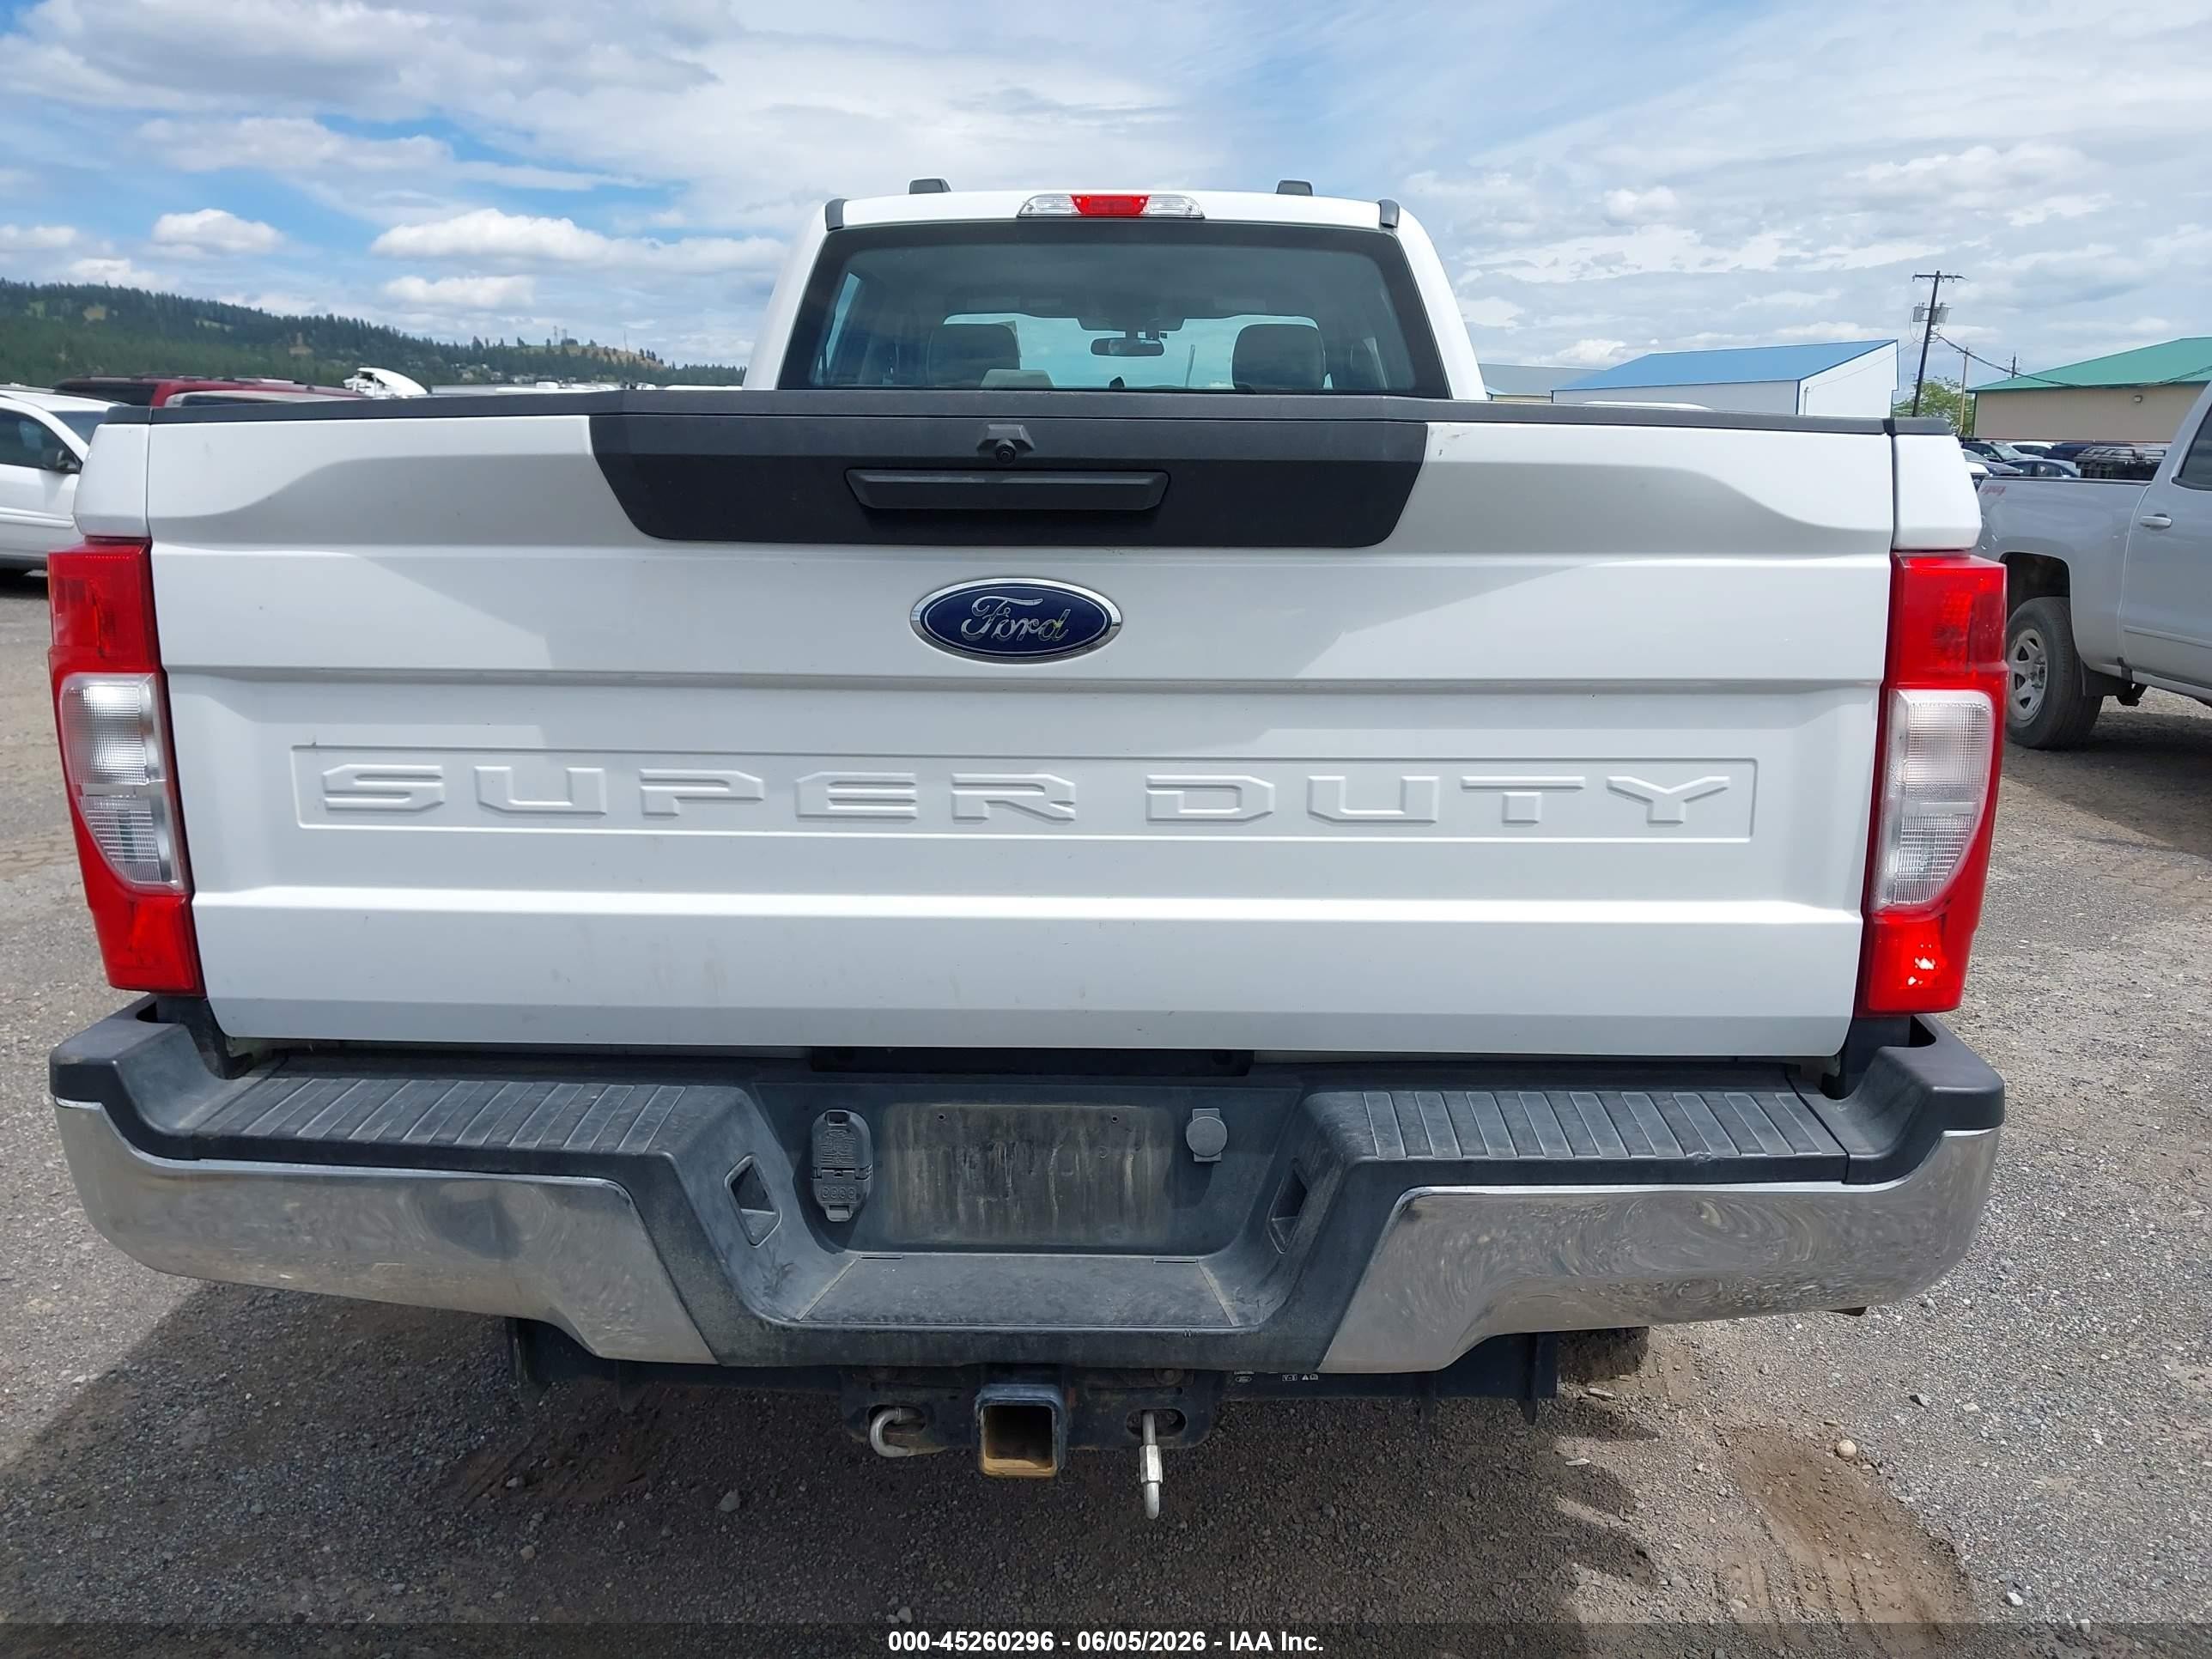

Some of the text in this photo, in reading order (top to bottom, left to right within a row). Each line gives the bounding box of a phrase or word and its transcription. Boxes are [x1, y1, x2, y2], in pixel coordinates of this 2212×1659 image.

[961, 595, 1072, 641] Ford
[323, 763, 1732, 825] SUPER DUTY
